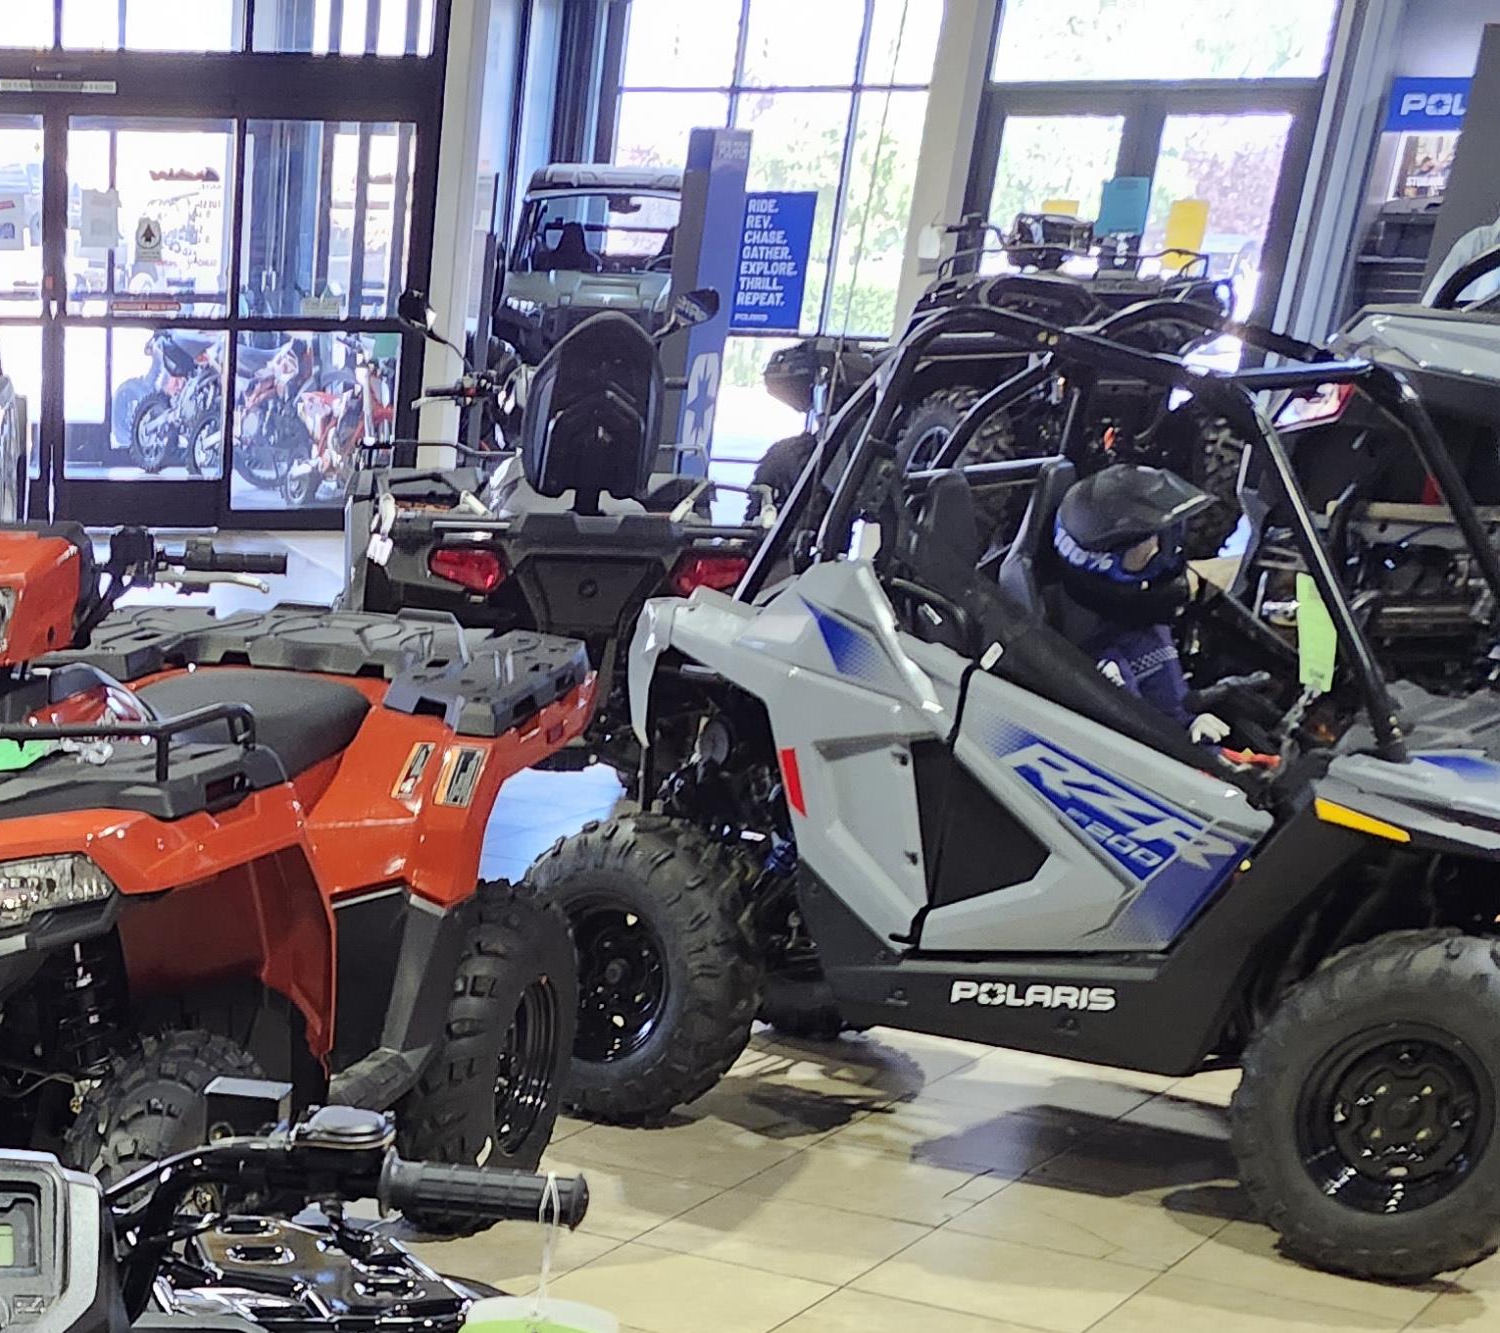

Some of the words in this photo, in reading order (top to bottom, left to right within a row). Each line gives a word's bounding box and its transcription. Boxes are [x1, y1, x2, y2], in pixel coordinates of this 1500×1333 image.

[747, 199, 779, 213] RIDE.
[746, 215, 773, 229] REV.
[743, 230, 788, 244] CHASE.
[741, 246, 792, 260] GATHER.
[740, 262, 798, 276] EXPLORE.
[738, 277, 784, 291] THRILL.
[736, 292, 785, 306] REPEAT.
[1053, 526, 1114, 571] 100%
[1085, 821, 1164, 868] 200
[950, 980, 1117, 1012] POLARIS
